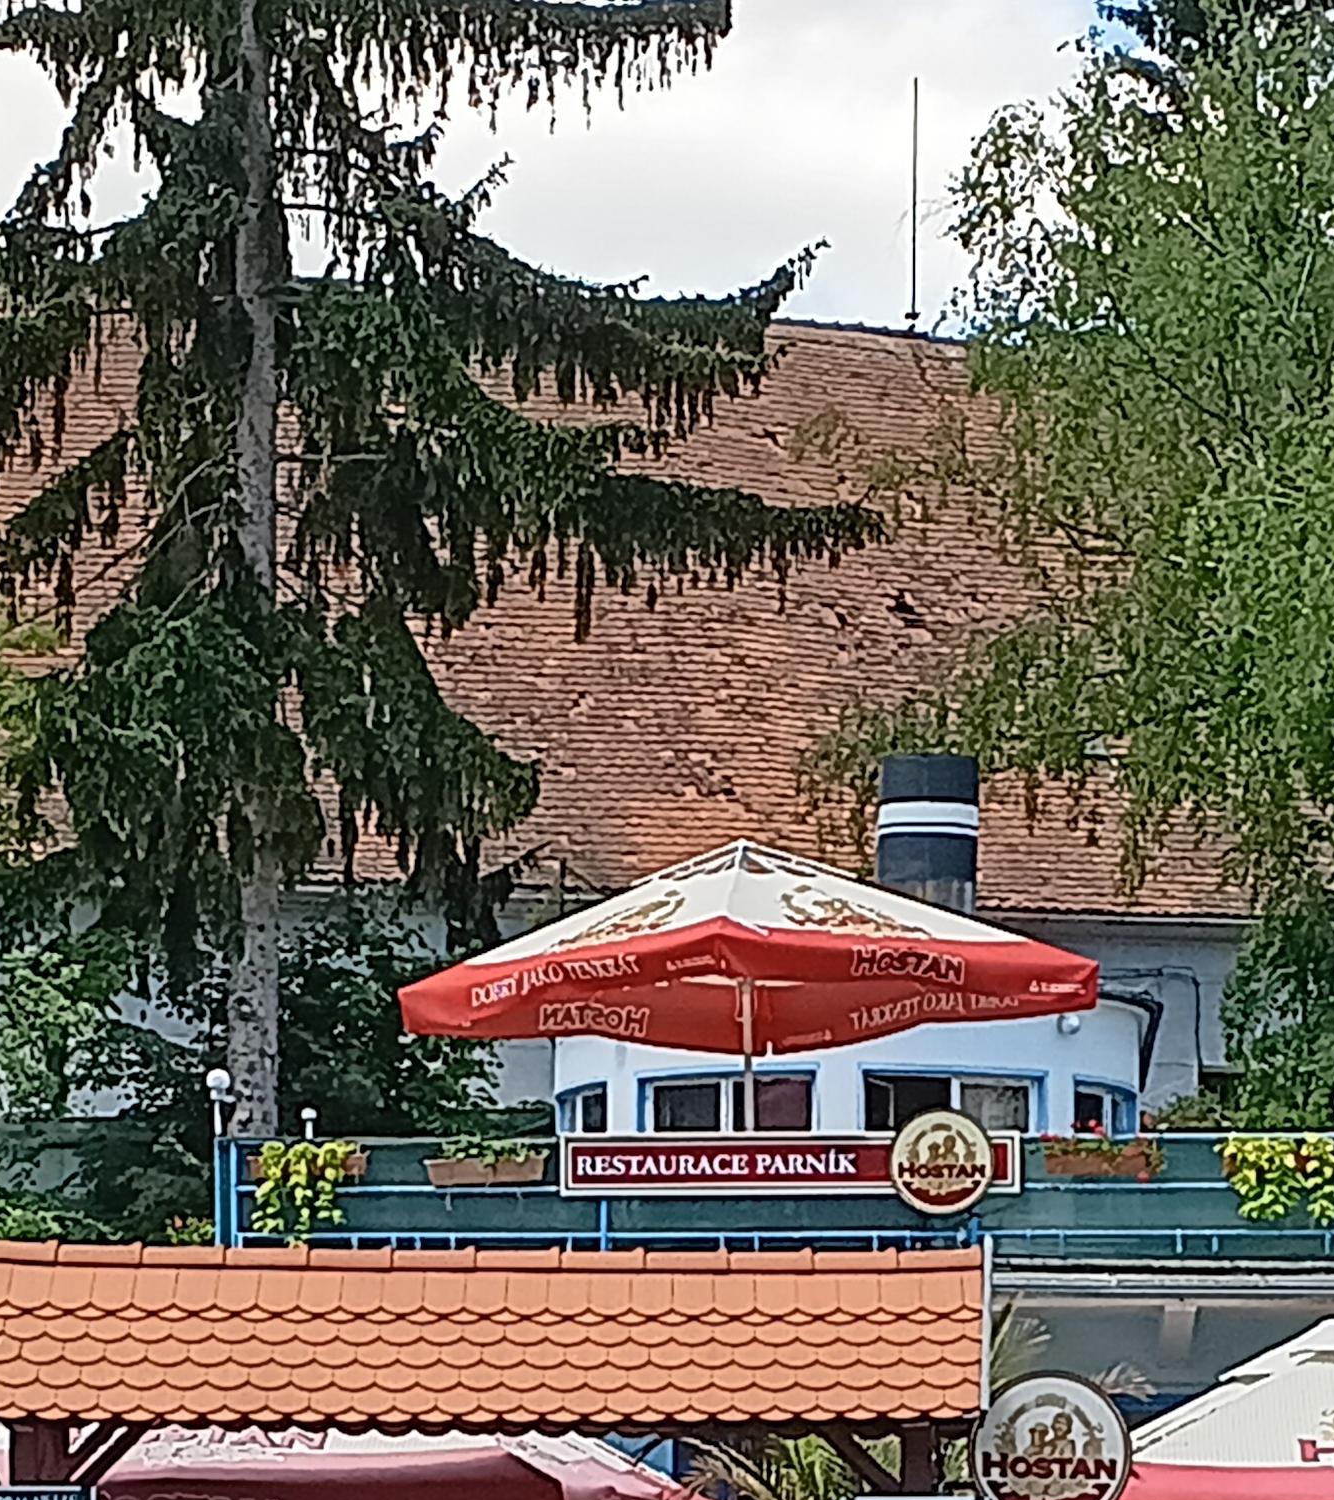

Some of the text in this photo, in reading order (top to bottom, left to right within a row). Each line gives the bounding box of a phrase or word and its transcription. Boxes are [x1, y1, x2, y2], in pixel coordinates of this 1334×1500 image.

[521, 962, 564, 996] JAKO
[850, 945, 965, 985] HOSTAN
[576, 1147, 857, 1176] RESTAURACE PARNÍK
[898, 1161, 986, 1178] HOSTAN
[981, 1450, 1117, 1481] HOSTAN
